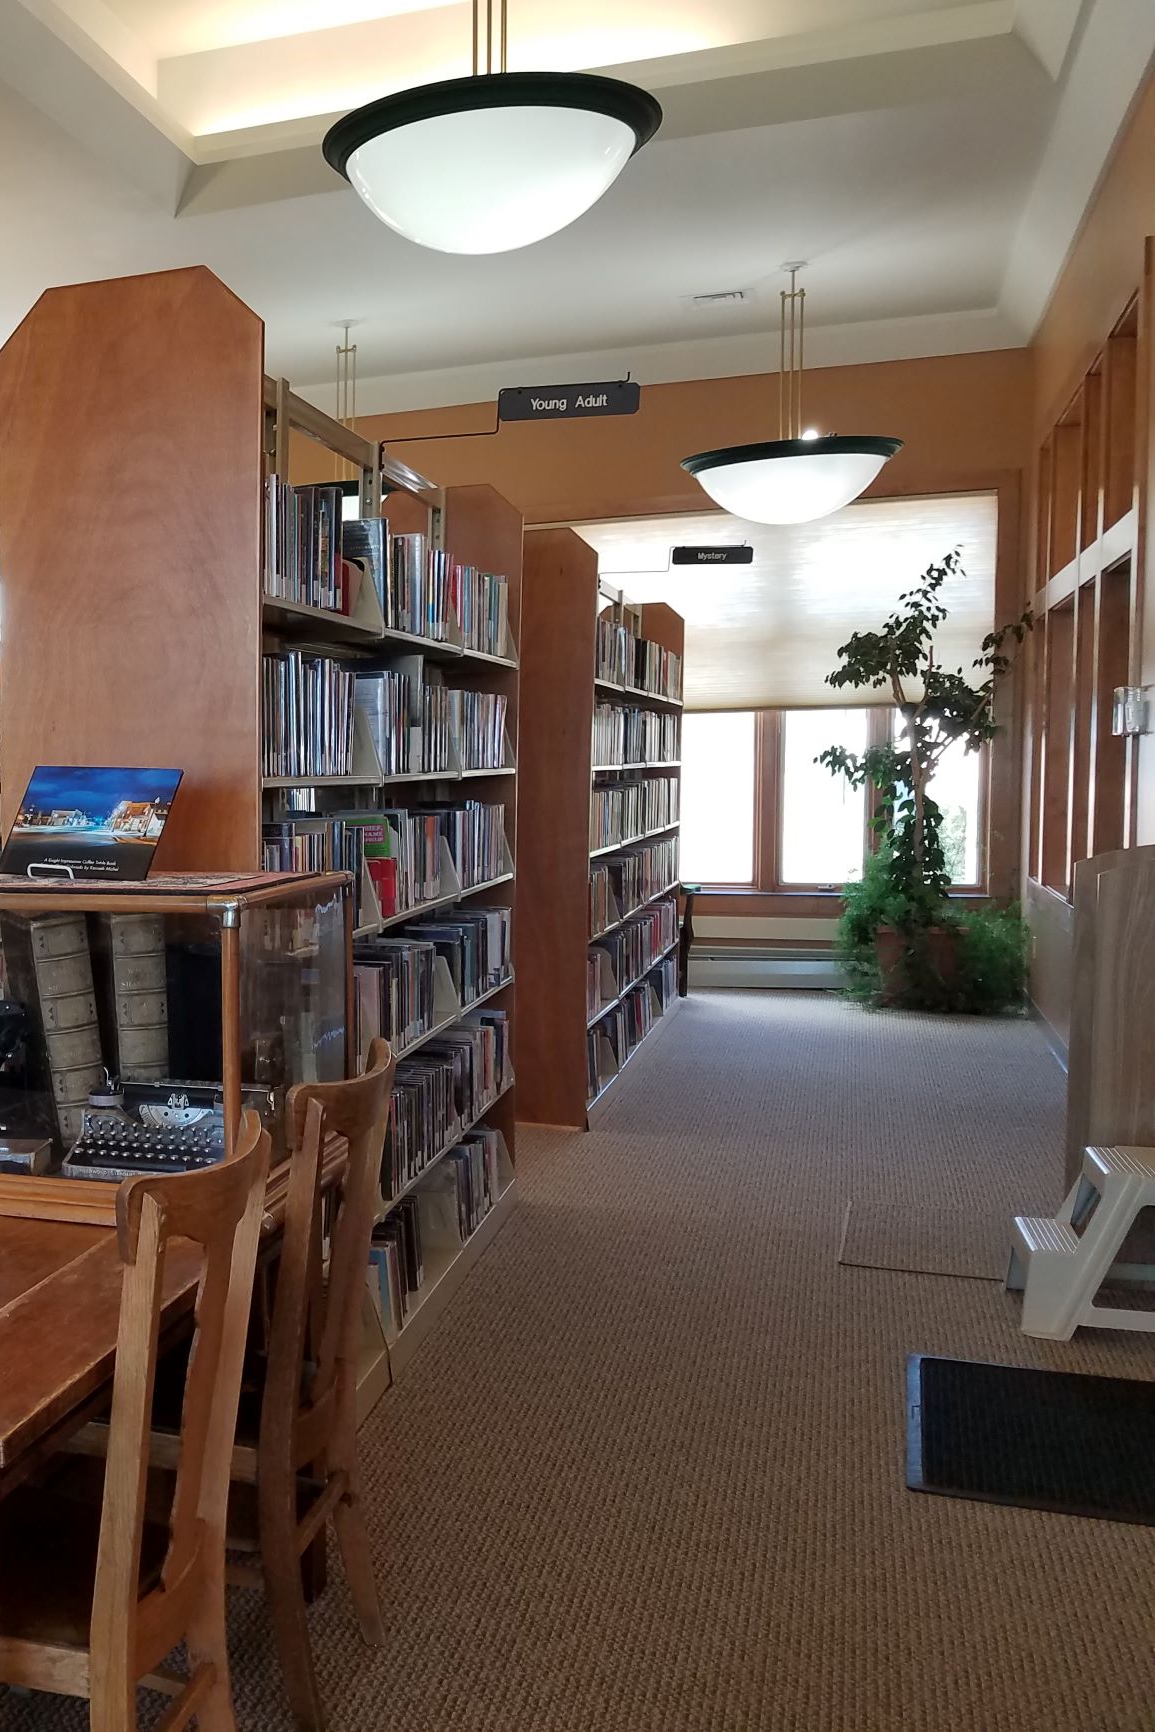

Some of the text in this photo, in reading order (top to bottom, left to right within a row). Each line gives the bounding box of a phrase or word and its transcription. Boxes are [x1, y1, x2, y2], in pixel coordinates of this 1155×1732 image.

[530, 394, 608, 411] Young Adult
[697, 552, 727, 561] Mystery
